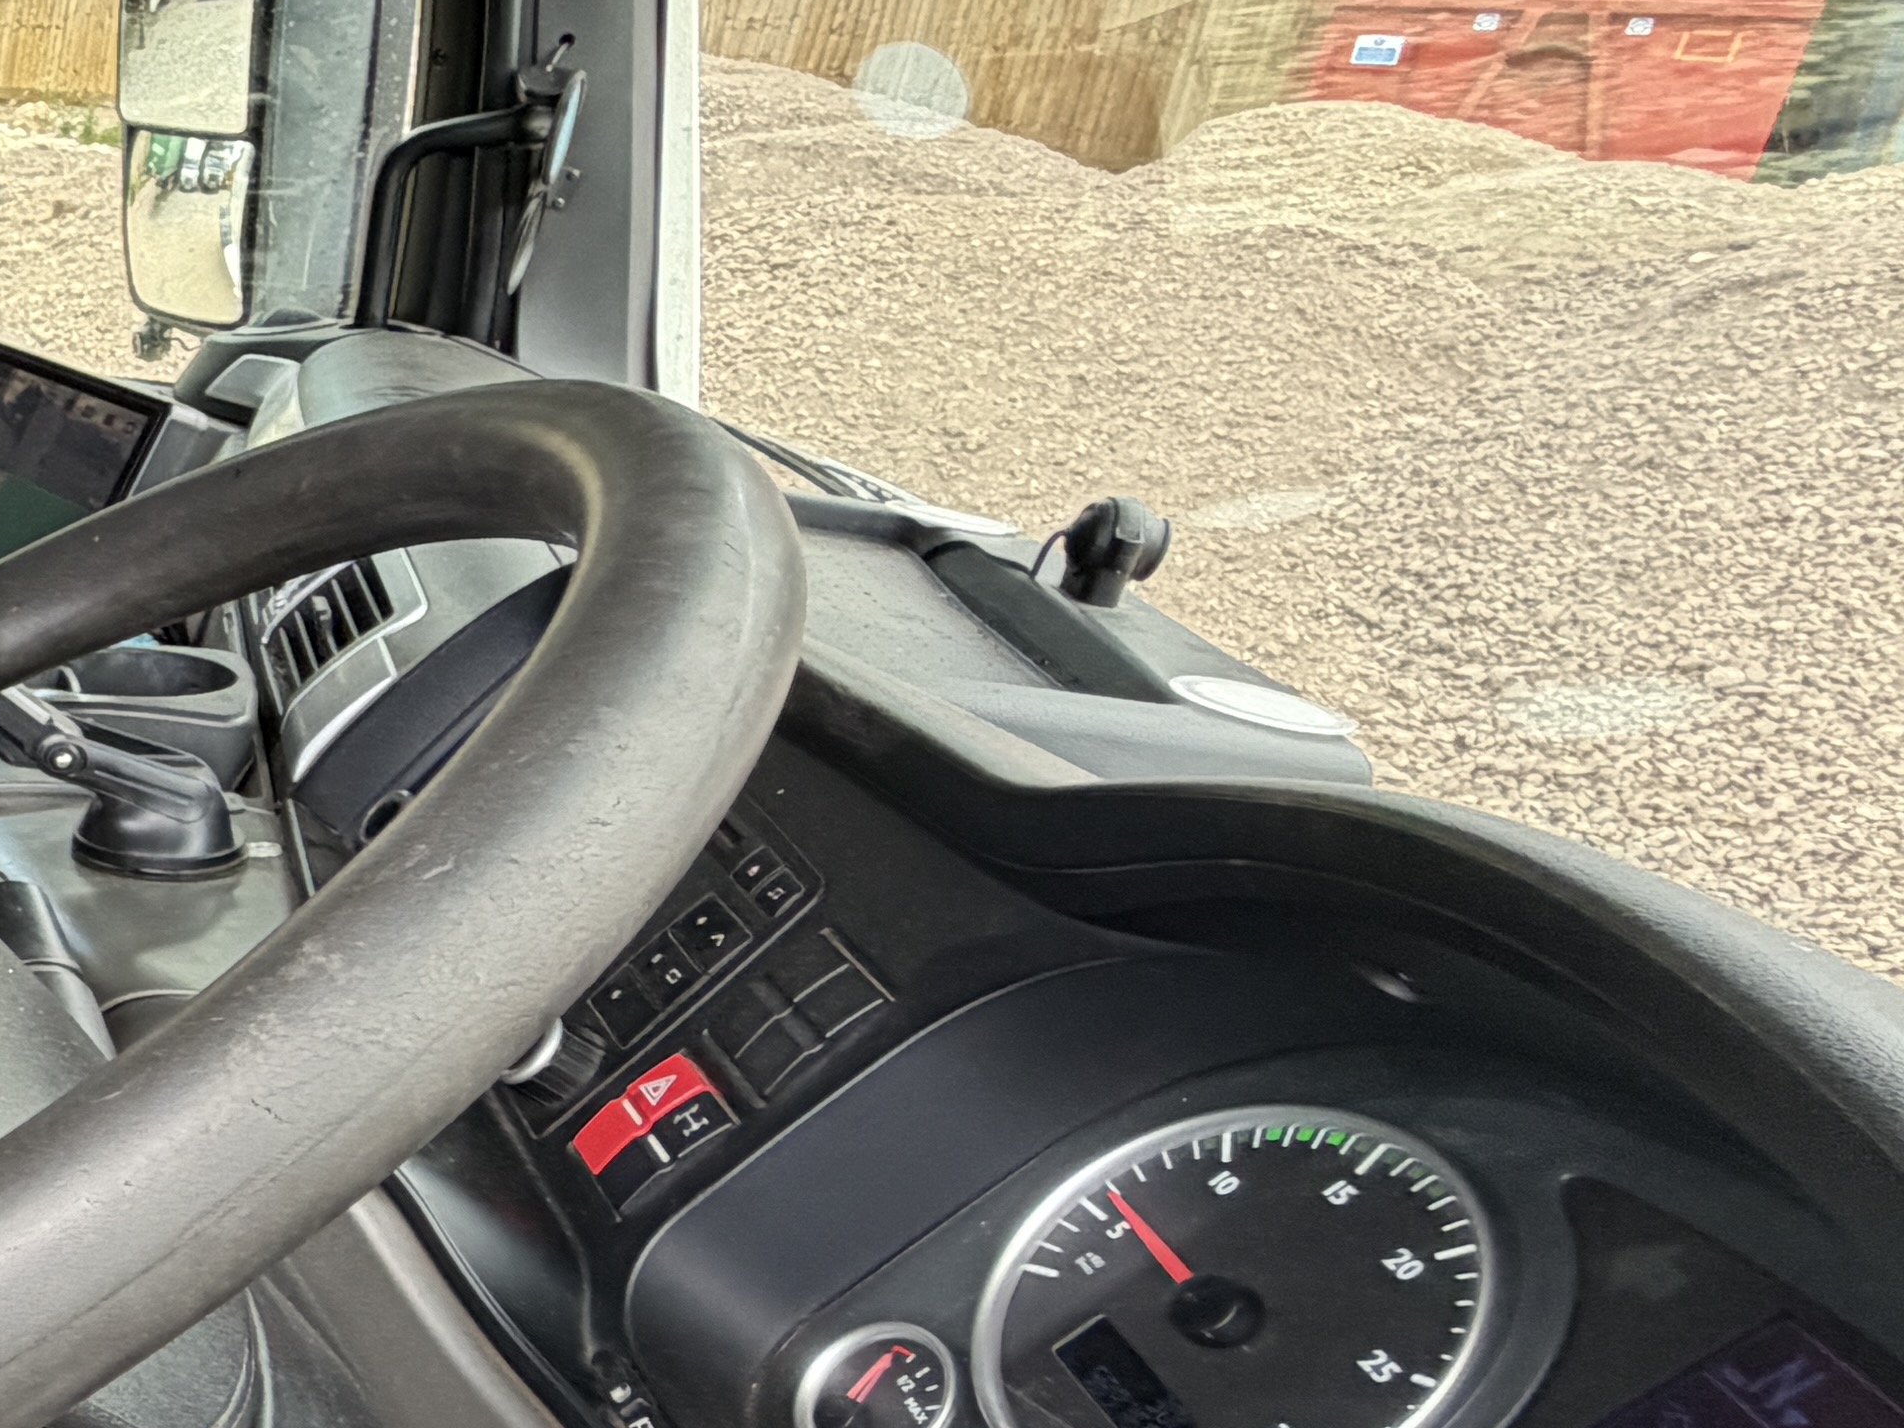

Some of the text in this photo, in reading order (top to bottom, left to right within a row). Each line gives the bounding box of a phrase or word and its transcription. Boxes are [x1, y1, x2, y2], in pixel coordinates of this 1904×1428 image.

[1208, 1171, 1240, 1197] 10
[1322, 1179, 1360, 1208] 15
[1105, 1220, 1131, 1239] 5
[1380, 1248, 1426, 1282] 20
[1356, 1349, 1401, 1385] 25
[903, 1396, 928, 1425] MAX
